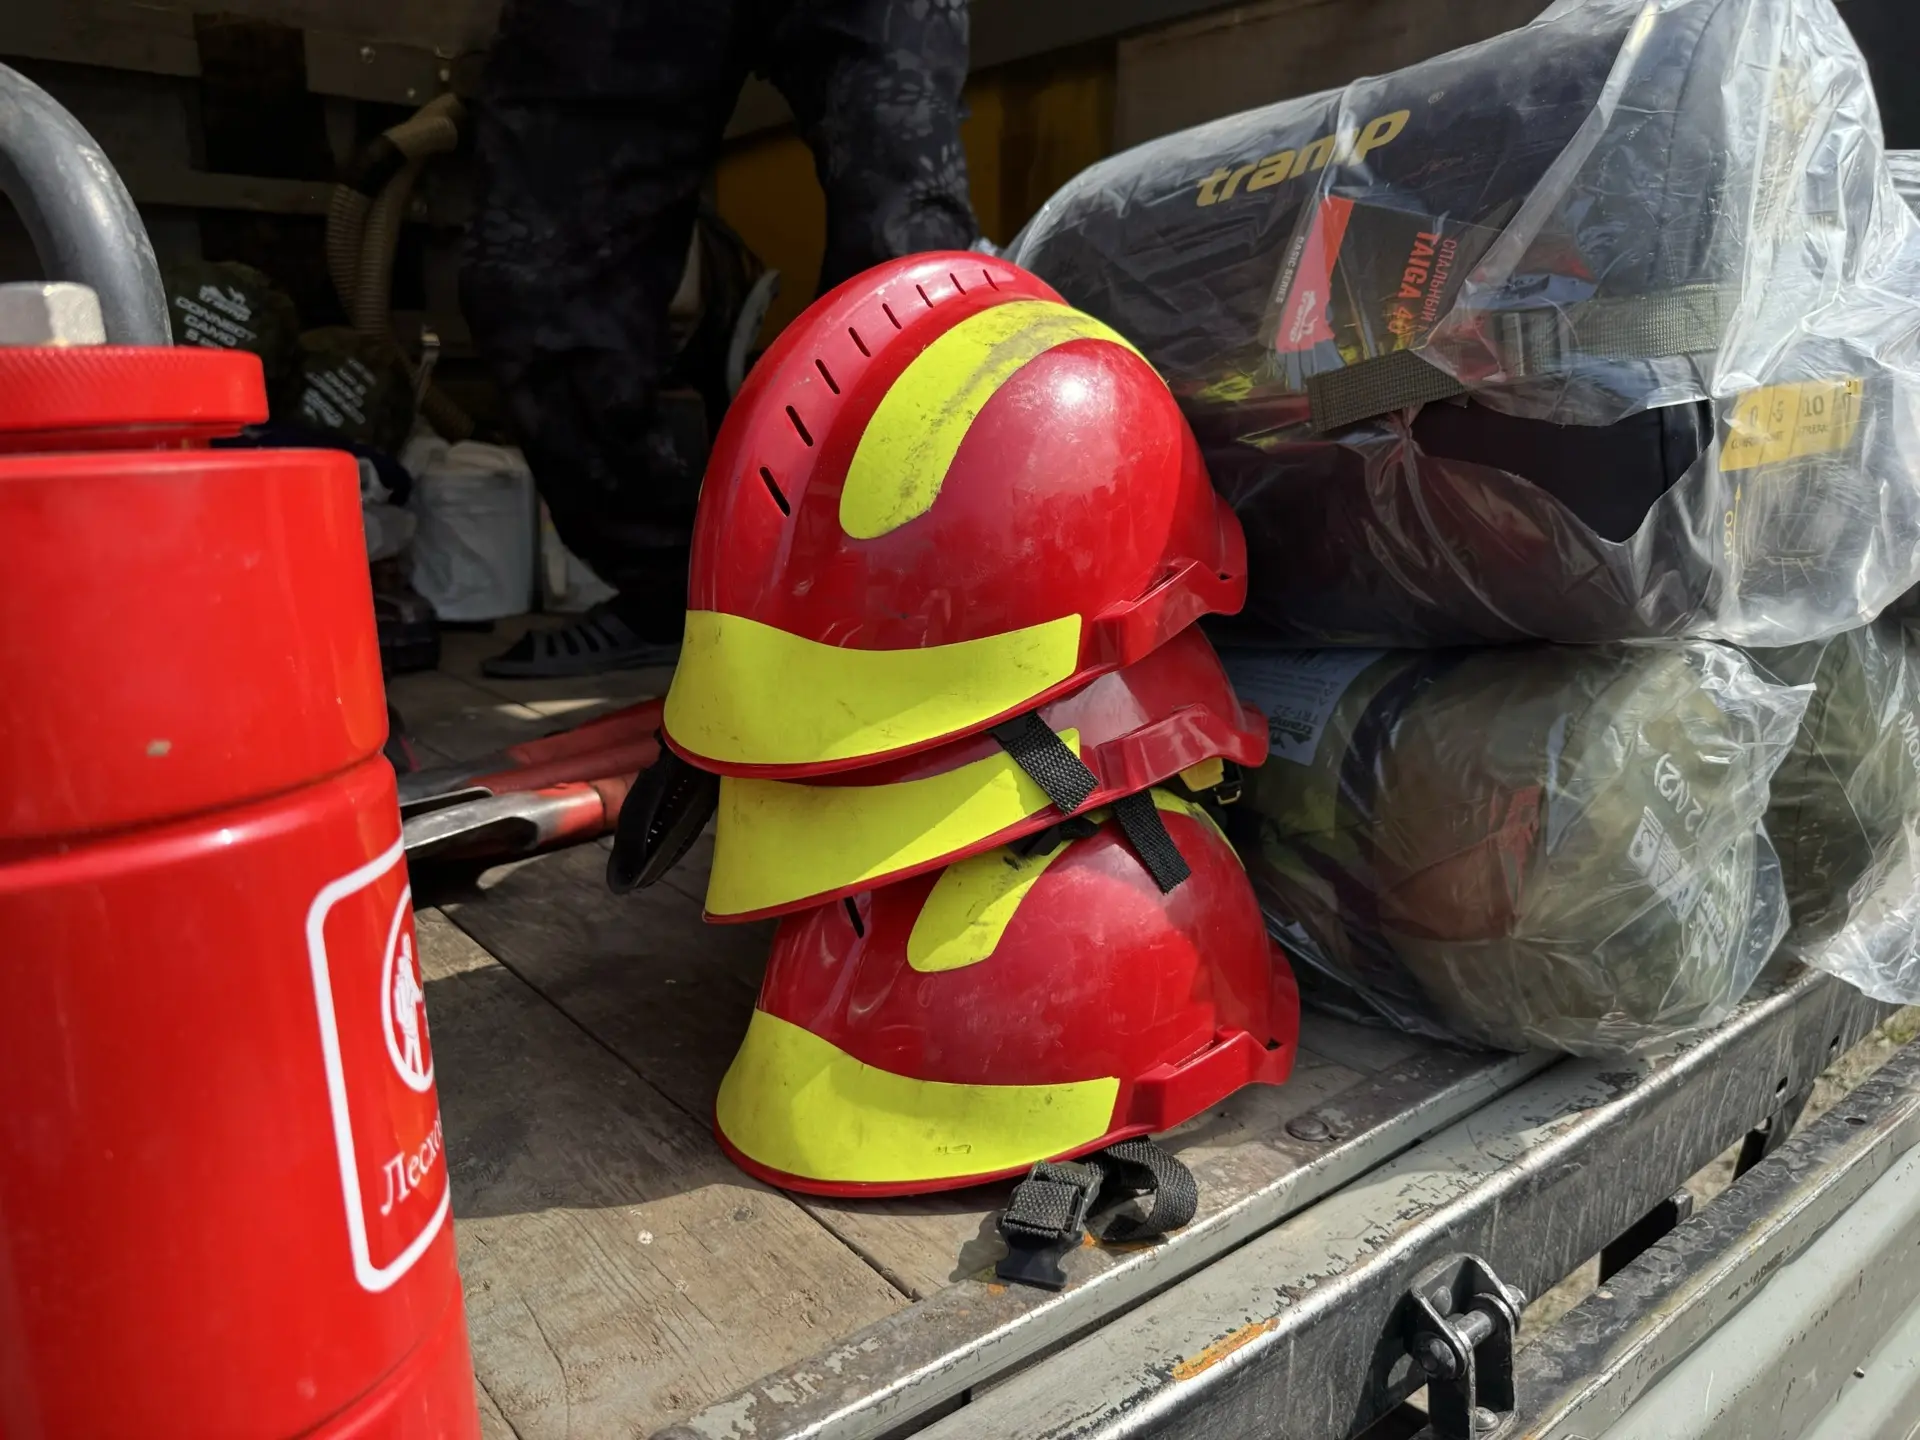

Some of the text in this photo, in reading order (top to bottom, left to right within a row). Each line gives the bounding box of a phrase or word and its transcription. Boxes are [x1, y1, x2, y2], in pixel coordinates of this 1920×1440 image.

[1197, 110, 1411, 207] tramp
[1275, 268, 1294, 304] SERIES
[1398, 231, 1442, 299] TAIGA
[1420, 238, 1458, 323] СПАЛЬНЫЙ
[175, 296, 257, 341] CONNECT
[380, 1110, 443, 1216] Лесхо
